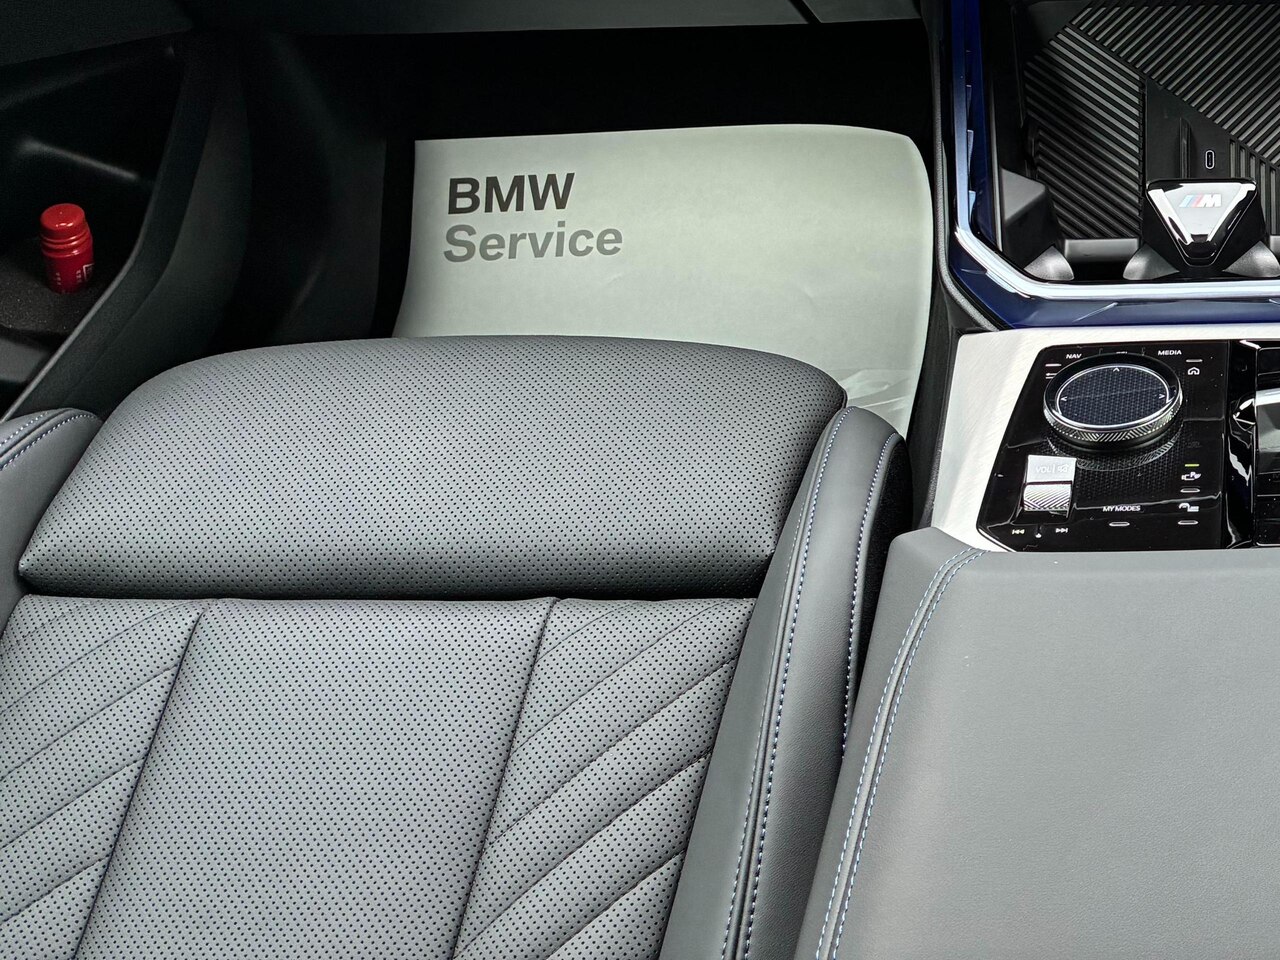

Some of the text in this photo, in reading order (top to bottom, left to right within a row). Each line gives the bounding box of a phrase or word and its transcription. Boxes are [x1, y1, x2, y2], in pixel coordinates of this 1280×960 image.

[447, 172, 575, 215] BMW
[443, 221, 624, 263] Service
[1035, 466, 1052, 474] VOL
